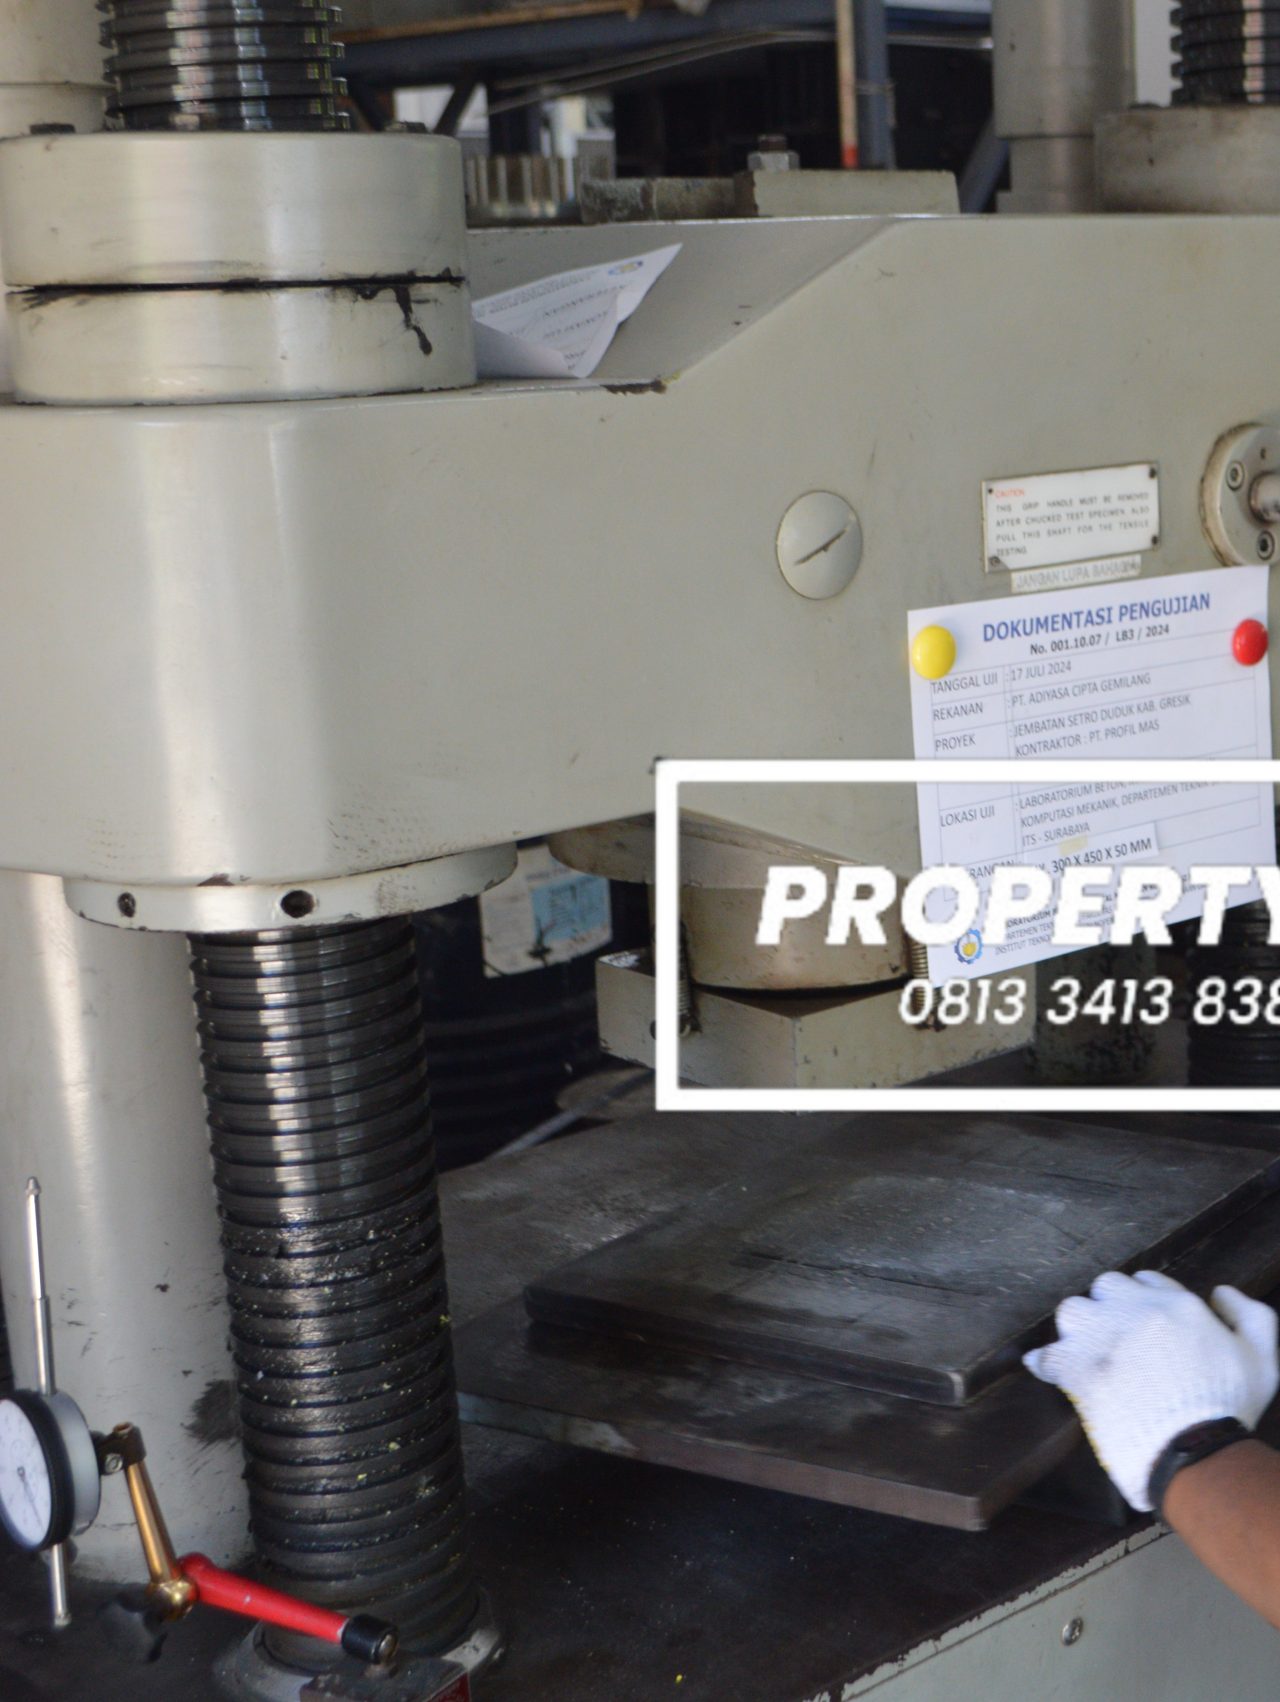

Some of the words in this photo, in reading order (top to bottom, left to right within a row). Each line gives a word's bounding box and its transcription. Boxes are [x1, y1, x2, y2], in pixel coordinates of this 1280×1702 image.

[996, 504, 1012, 512] THIS
[1022, 502, 1039, 510] GRIP
[1047, 499, 1073, 508] HANDLE
[1079, 496, 1097, 505] MUST
[1103, 495, 1111, 503] BE
[1117, 492, 1149, 501] REMOVED
[996, 517, 1021, 528] AFTER
[1025, 513, 1062, 525] CHUCKED
[1066, 511, 1084, 521] TEST
[1131, 505, 1149, 514] ALSO
[996, 533, 1016, 542] PULL
[1022, 531, 1040, 540] THIS
[1047, 527, 1072, 537] SHAFT
[1077, 525, 1093, 534] FOR
[1099, 522, 1112, 531] THE
[1119, 519, 1149, 529] TENSILE
[1062, 566, 1089, 582] LUPA
[983, 607, 1113, 642] DOKUMENTASI
[1118, 592, 1211, 623] PENGUJIAN
[1030, 643, 1047, 656] No.
[1115, 628, 1134, 643] LB3
[1145, 624, 1169, 638] 2024
[931, 675, 980, 695] TANGGAL
[982, 672, 998, 686] UJI
[1025, 664, 1045, 680] JULI
[1048, 660, 1072, 676] 2024
[933, 702, 984, 722] REKANAN
[1028, 685, 1070, 705] ADIYASA
[1071, 681, 1099, 698] CIPTA
[1100, 672, 1151, 693] GEMILANG
[1013, 717, 1065, 739] JEMBATAN
[1067, 711, 1099, 728] SETRO
[1100, 704, 1136, 721] DUDUK
[1159, 694, 1191, 710] GRESIK
[934, 734, 976, 752] PROYEK
[1015, 734, 1081, 758] KONTRAKTOR
[1104, 723, 1136, 741] PROFIL
[1138, 719, 1160, 733] MAS
[940, 808, 977, 828] LOKASI
[979, 805, 995, 820] UJI
[1019, 783, 1093, 810] LABORATORIUM
[1020, 807, 1075, 828] KOMPUTASI
[1121, 783, 1178, 806] DEPARTEMEN
[1022, 834, 1037, 847] ITS
[1044, 822, 1091, 841] SURABAYA
[1073, 854, 1082, 866] X
[1083, 849, 1103, 864] 450
[1104, 848, 1113, 861] X
[1114, 843, 1128, 858] 50
[1129, 838, 1151, 854] MM
